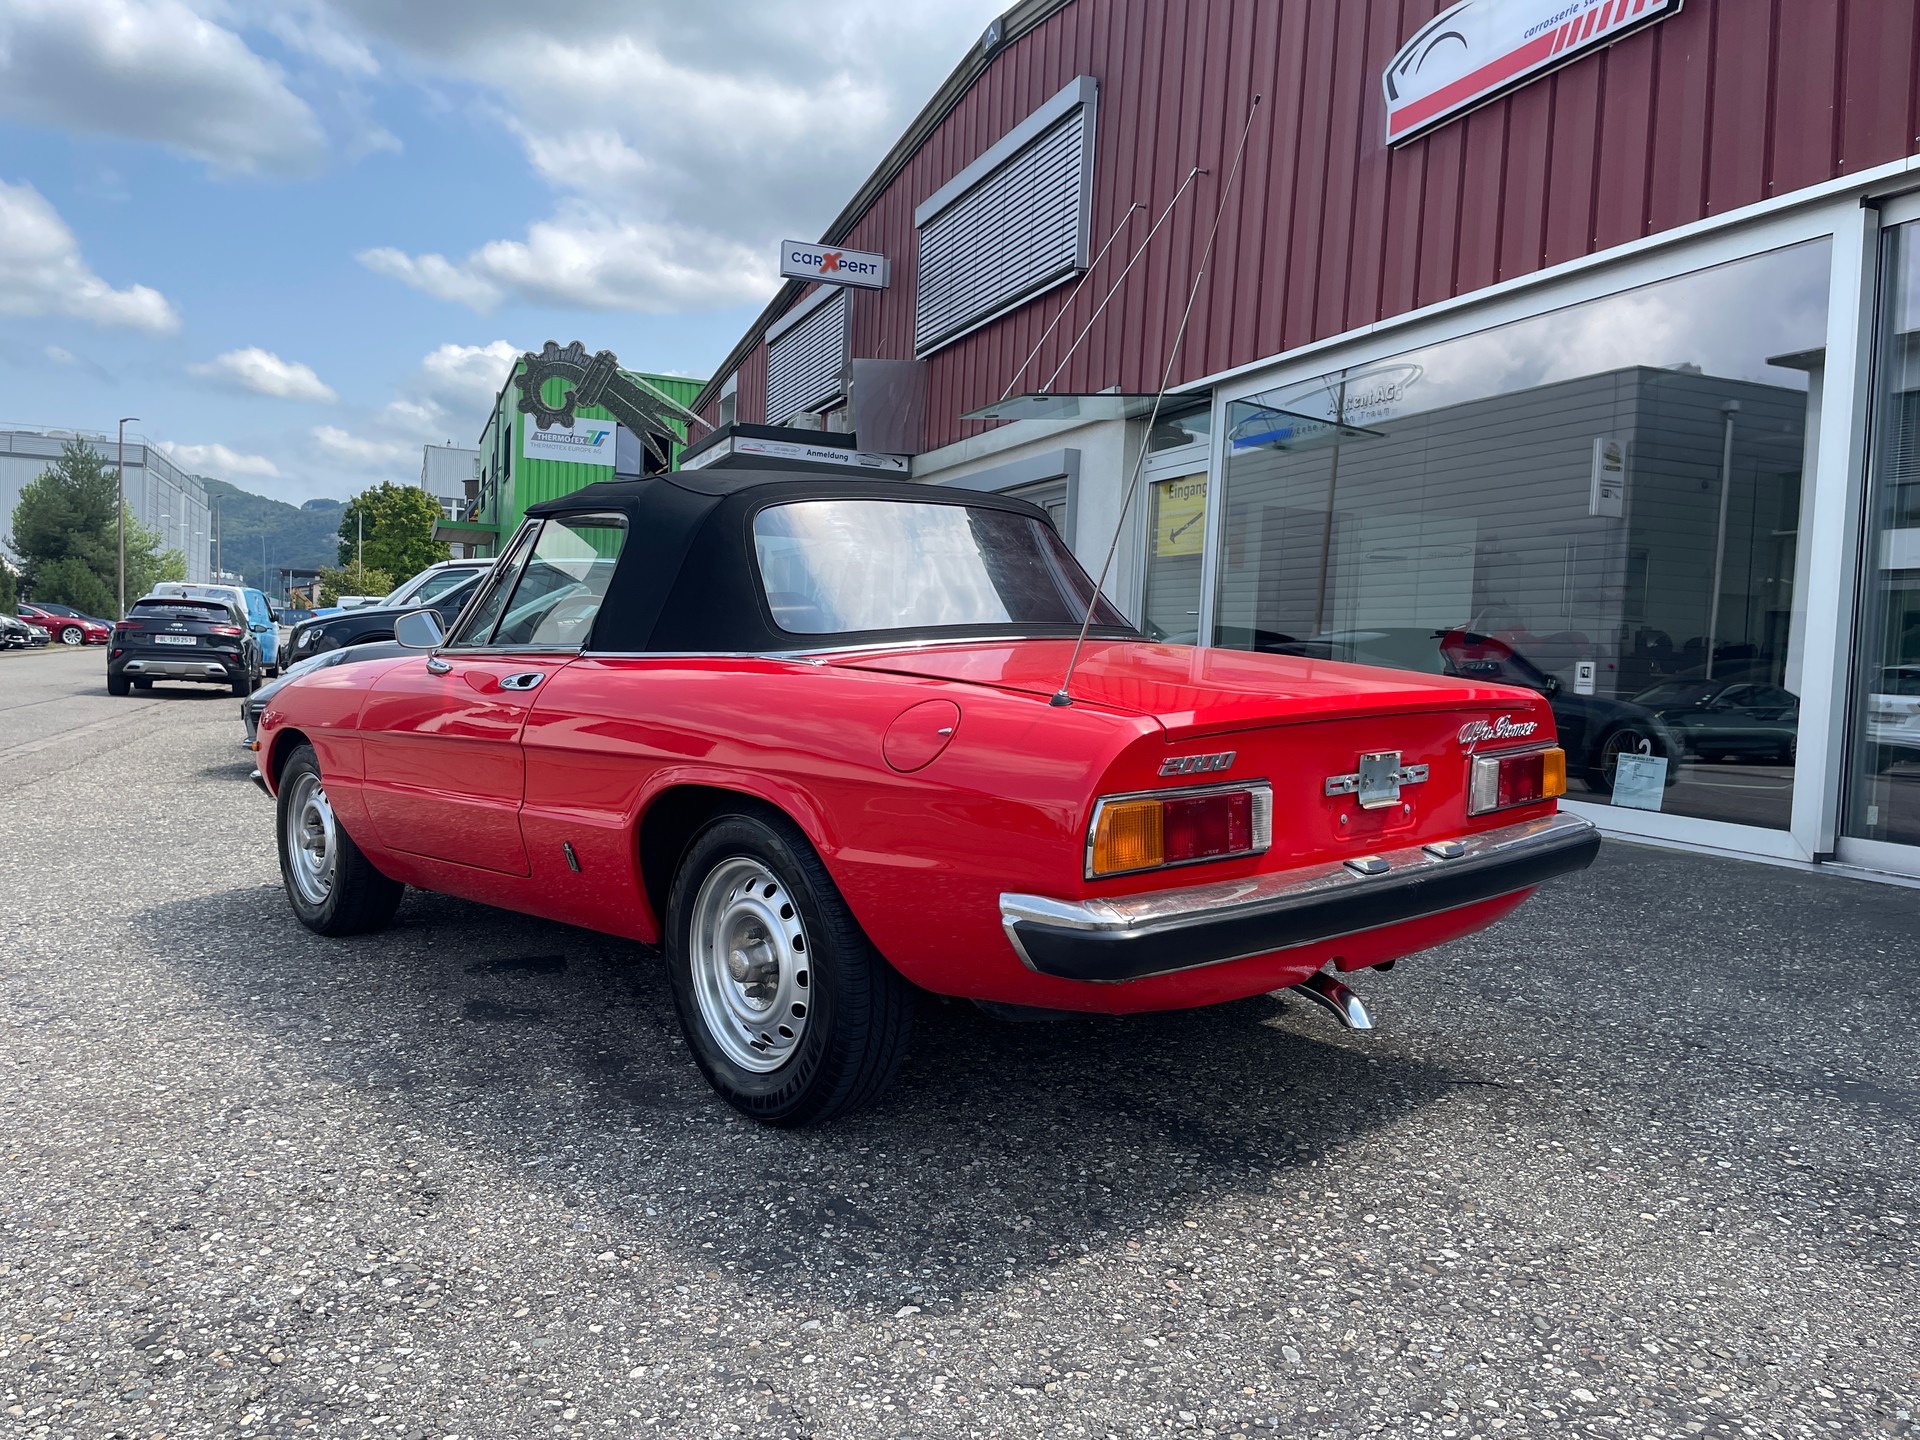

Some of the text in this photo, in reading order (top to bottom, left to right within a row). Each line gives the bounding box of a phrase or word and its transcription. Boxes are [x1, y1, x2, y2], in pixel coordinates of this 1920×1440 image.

[1523, 2, 1579, 39] carrosserie
[530, 441, 568, 452] THERMOTEX
[567, 445, 592, 454] EUROPE
[536, 432, 585, 445] THERMOTEX
[806, 448, 849, 463] Anmeldung
[1168, 482, 1208, 501] Eingang
[1457, 719, 1494, 755] Alfa
[1157, 750, 1238, 777] 2000
